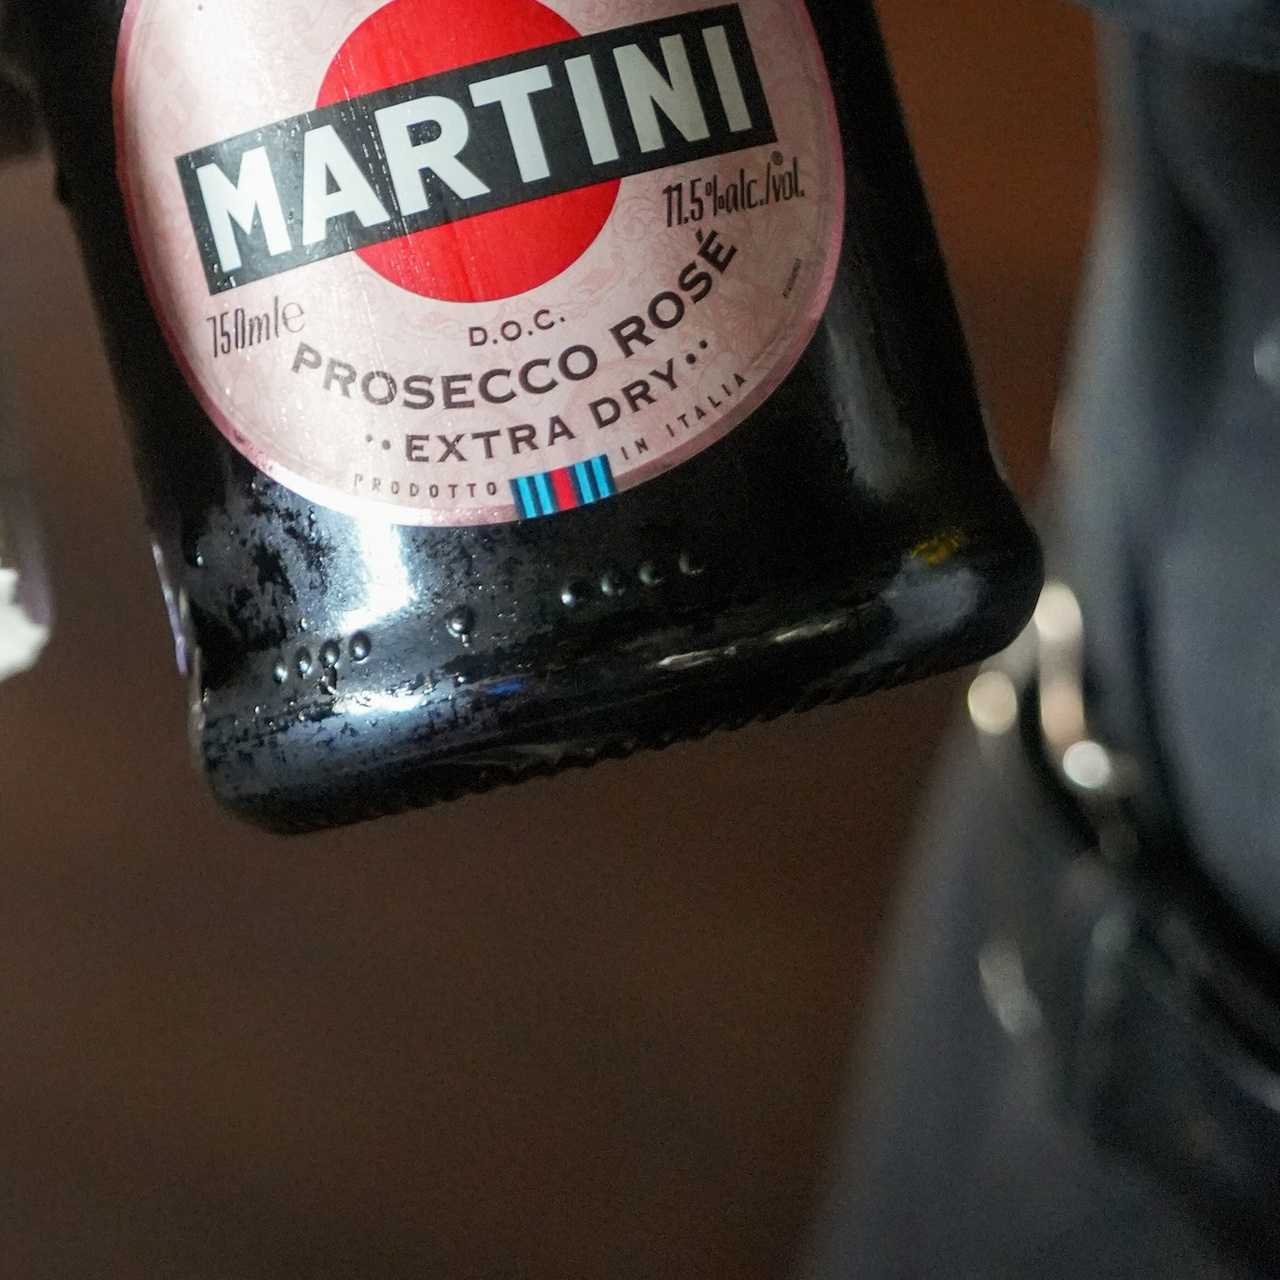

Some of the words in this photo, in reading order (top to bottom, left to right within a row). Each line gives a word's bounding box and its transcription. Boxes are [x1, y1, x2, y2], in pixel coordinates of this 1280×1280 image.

[196, 25, 753, 274] MARTINI
[291, 342, 598, 410] PROSECCO
[609, 228, 738, 358] ROSÉ
[469, 309, 565, 347] D.O.C.
[353, 473, 497, 498] PRODOTTO
[621, 437, 649, 460] IN
[666, 373, 747, 438] ITALIA
[405, 415, 576, 462] EXTRA
[588, 357, 678, 430] DRY
